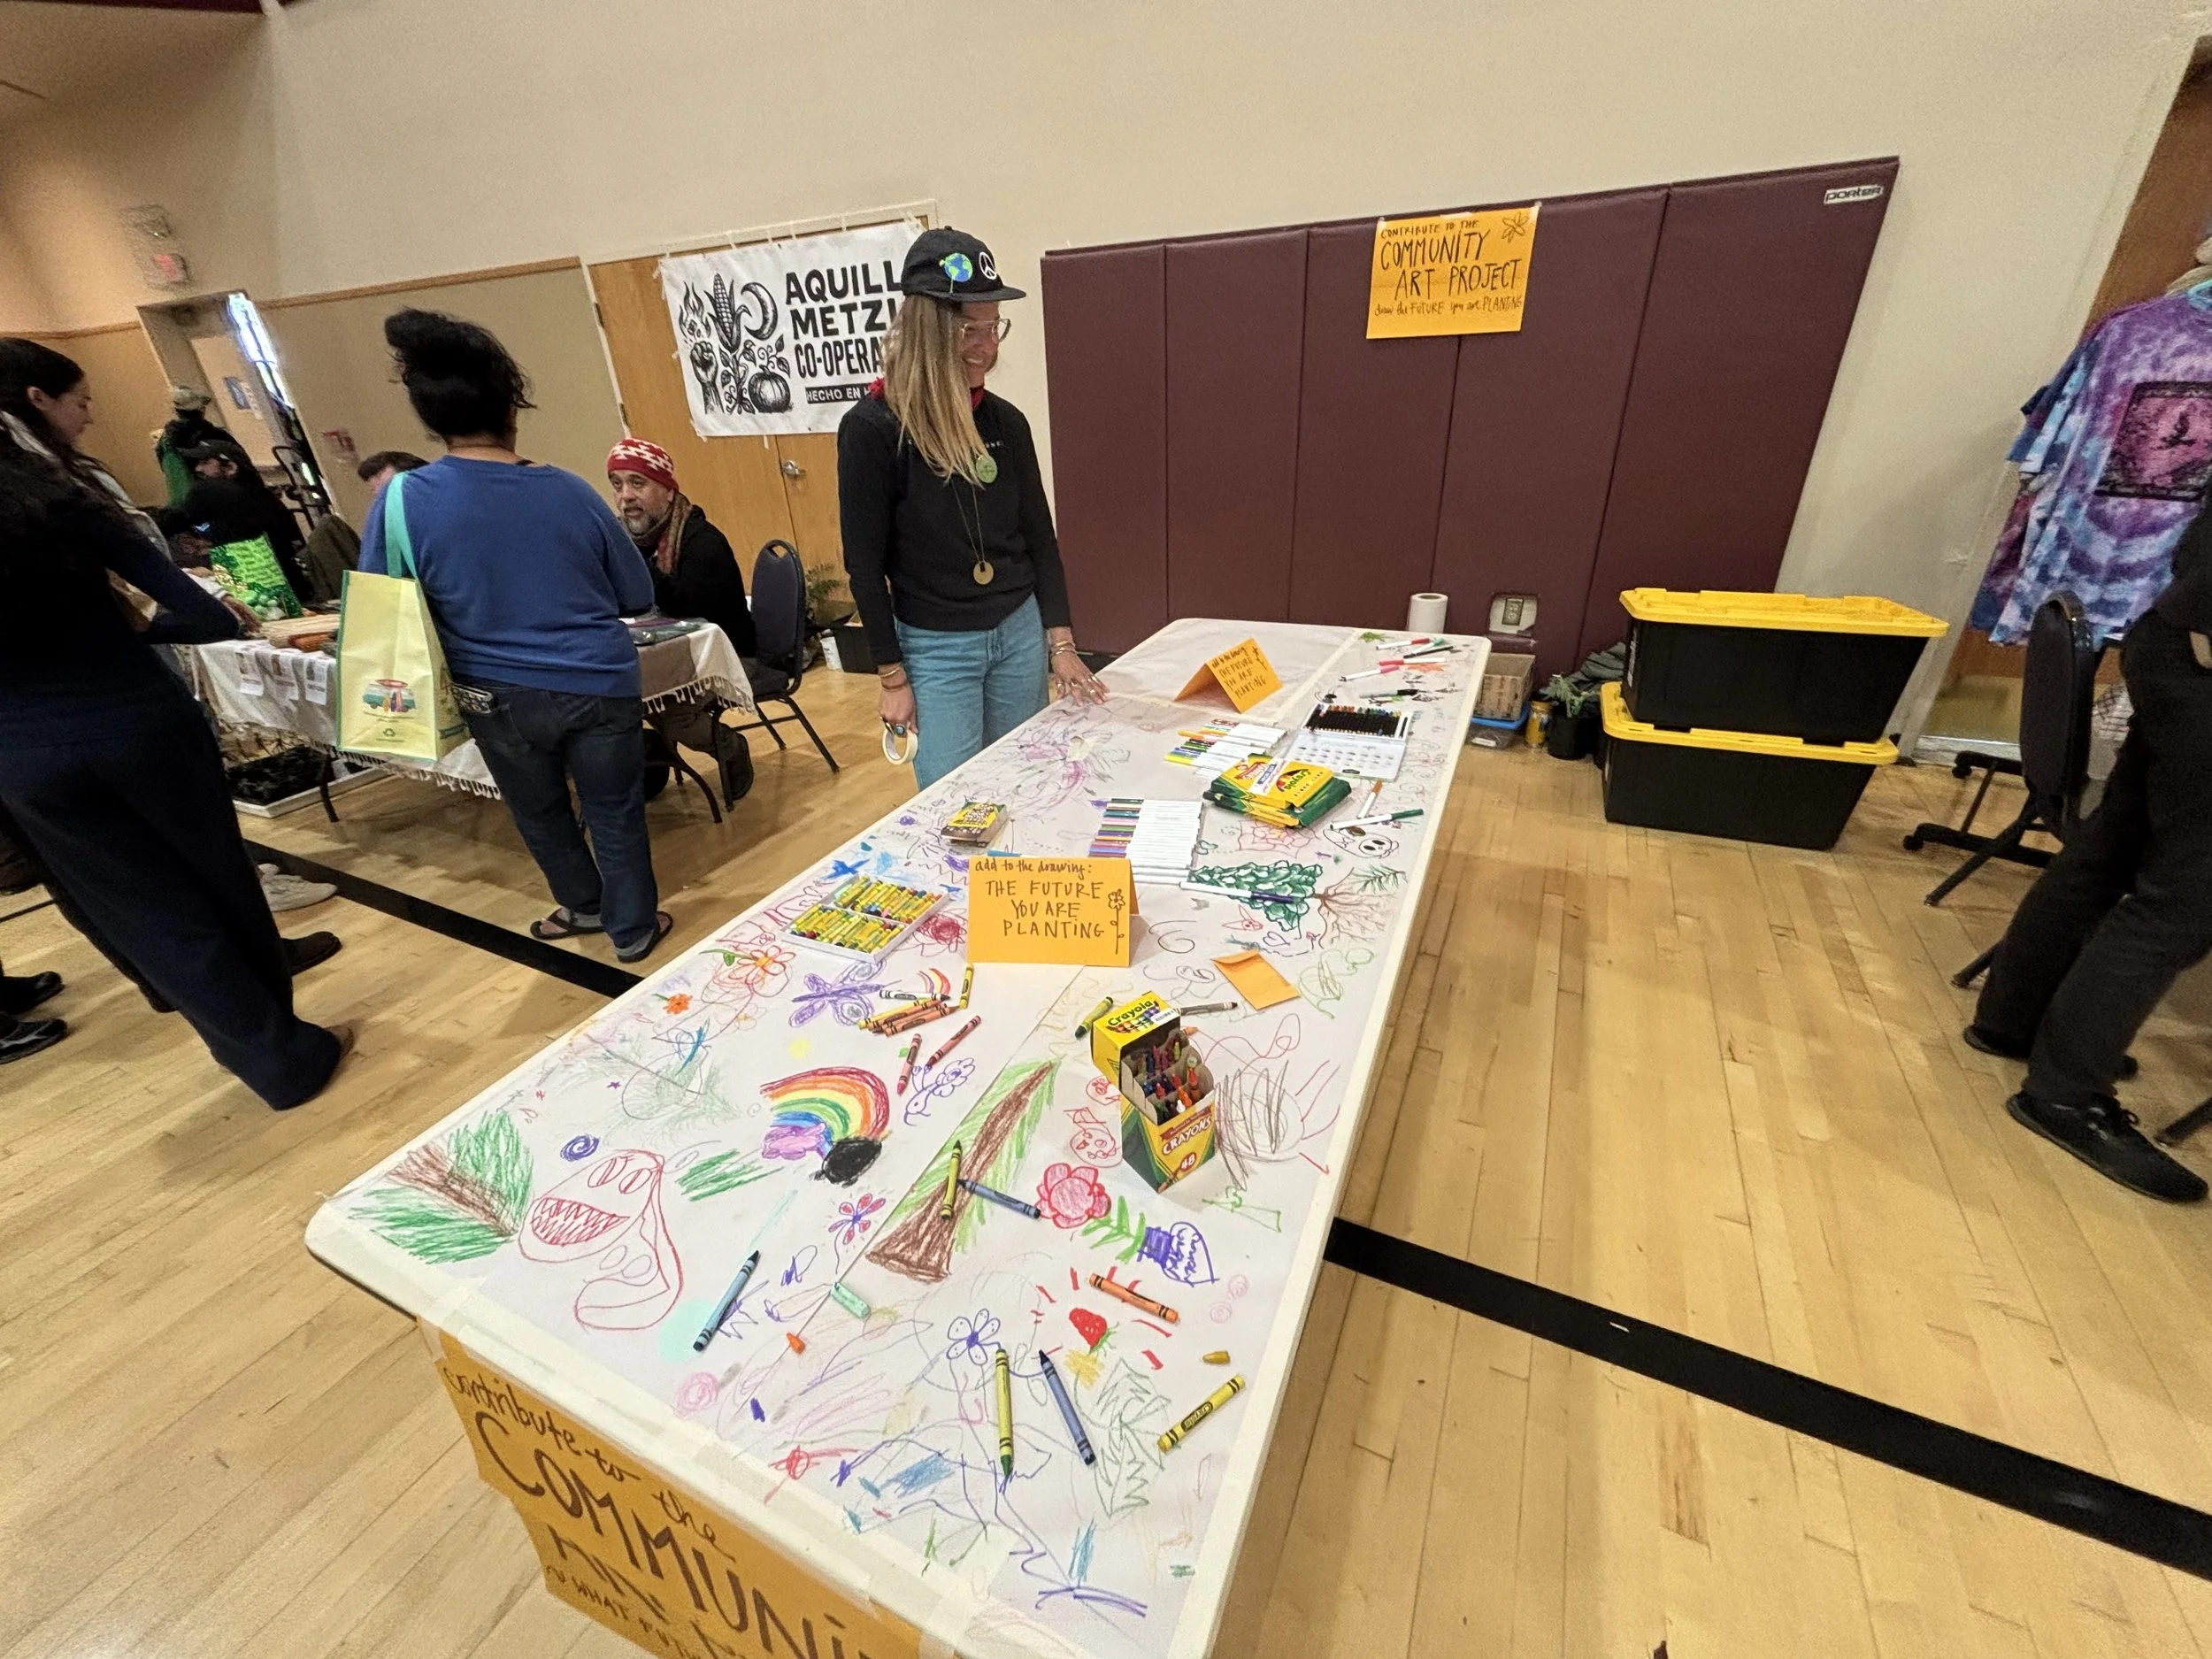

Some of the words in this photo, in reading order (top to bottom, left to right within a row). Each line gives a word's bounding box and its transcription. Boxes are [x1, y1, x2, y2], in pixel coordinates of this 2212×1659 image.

[1381, 224, 1440, 239] CONTRIBUTE
[1446, 222, 1455, 231] TO
[1380, 229, 1491, 270] COMMUNITY
[785, 259, 902, 305] AQUILL
[1394, 269, 1435, 300] ART
[1448, 258, 1522, 296] PROJECT
[1410, 302, 1445, 315] FUTURE
[795, 336, 882, 379] CO-OPERA
[806, 388, 842, 402] HECHO
[846, 386, 861, 399] EN
[975, 857, 997, 872] add
[1002, 859, 1014, 870] to
[1018, 859, 1033, 872] the
[986, 879, 1017, 897] THE
[1030, 879, 1103, 899] FUTURE
[1011, 899, 1039, 919] YOU
[1045, 901, 1080, 918] ARE
[1108, 1000, 1154, 1027] Crayola
[1162, 1116, 1211, 1155] CRAYONS
[1184, 1403, 1211, 1428] Crayola
[443, 1367, 582, 1455] contribute
[584, 1448, 641, 1482] to
[651, 1489, 736, 1563] the
[475, 1411, 872, 1659] COMMUN
